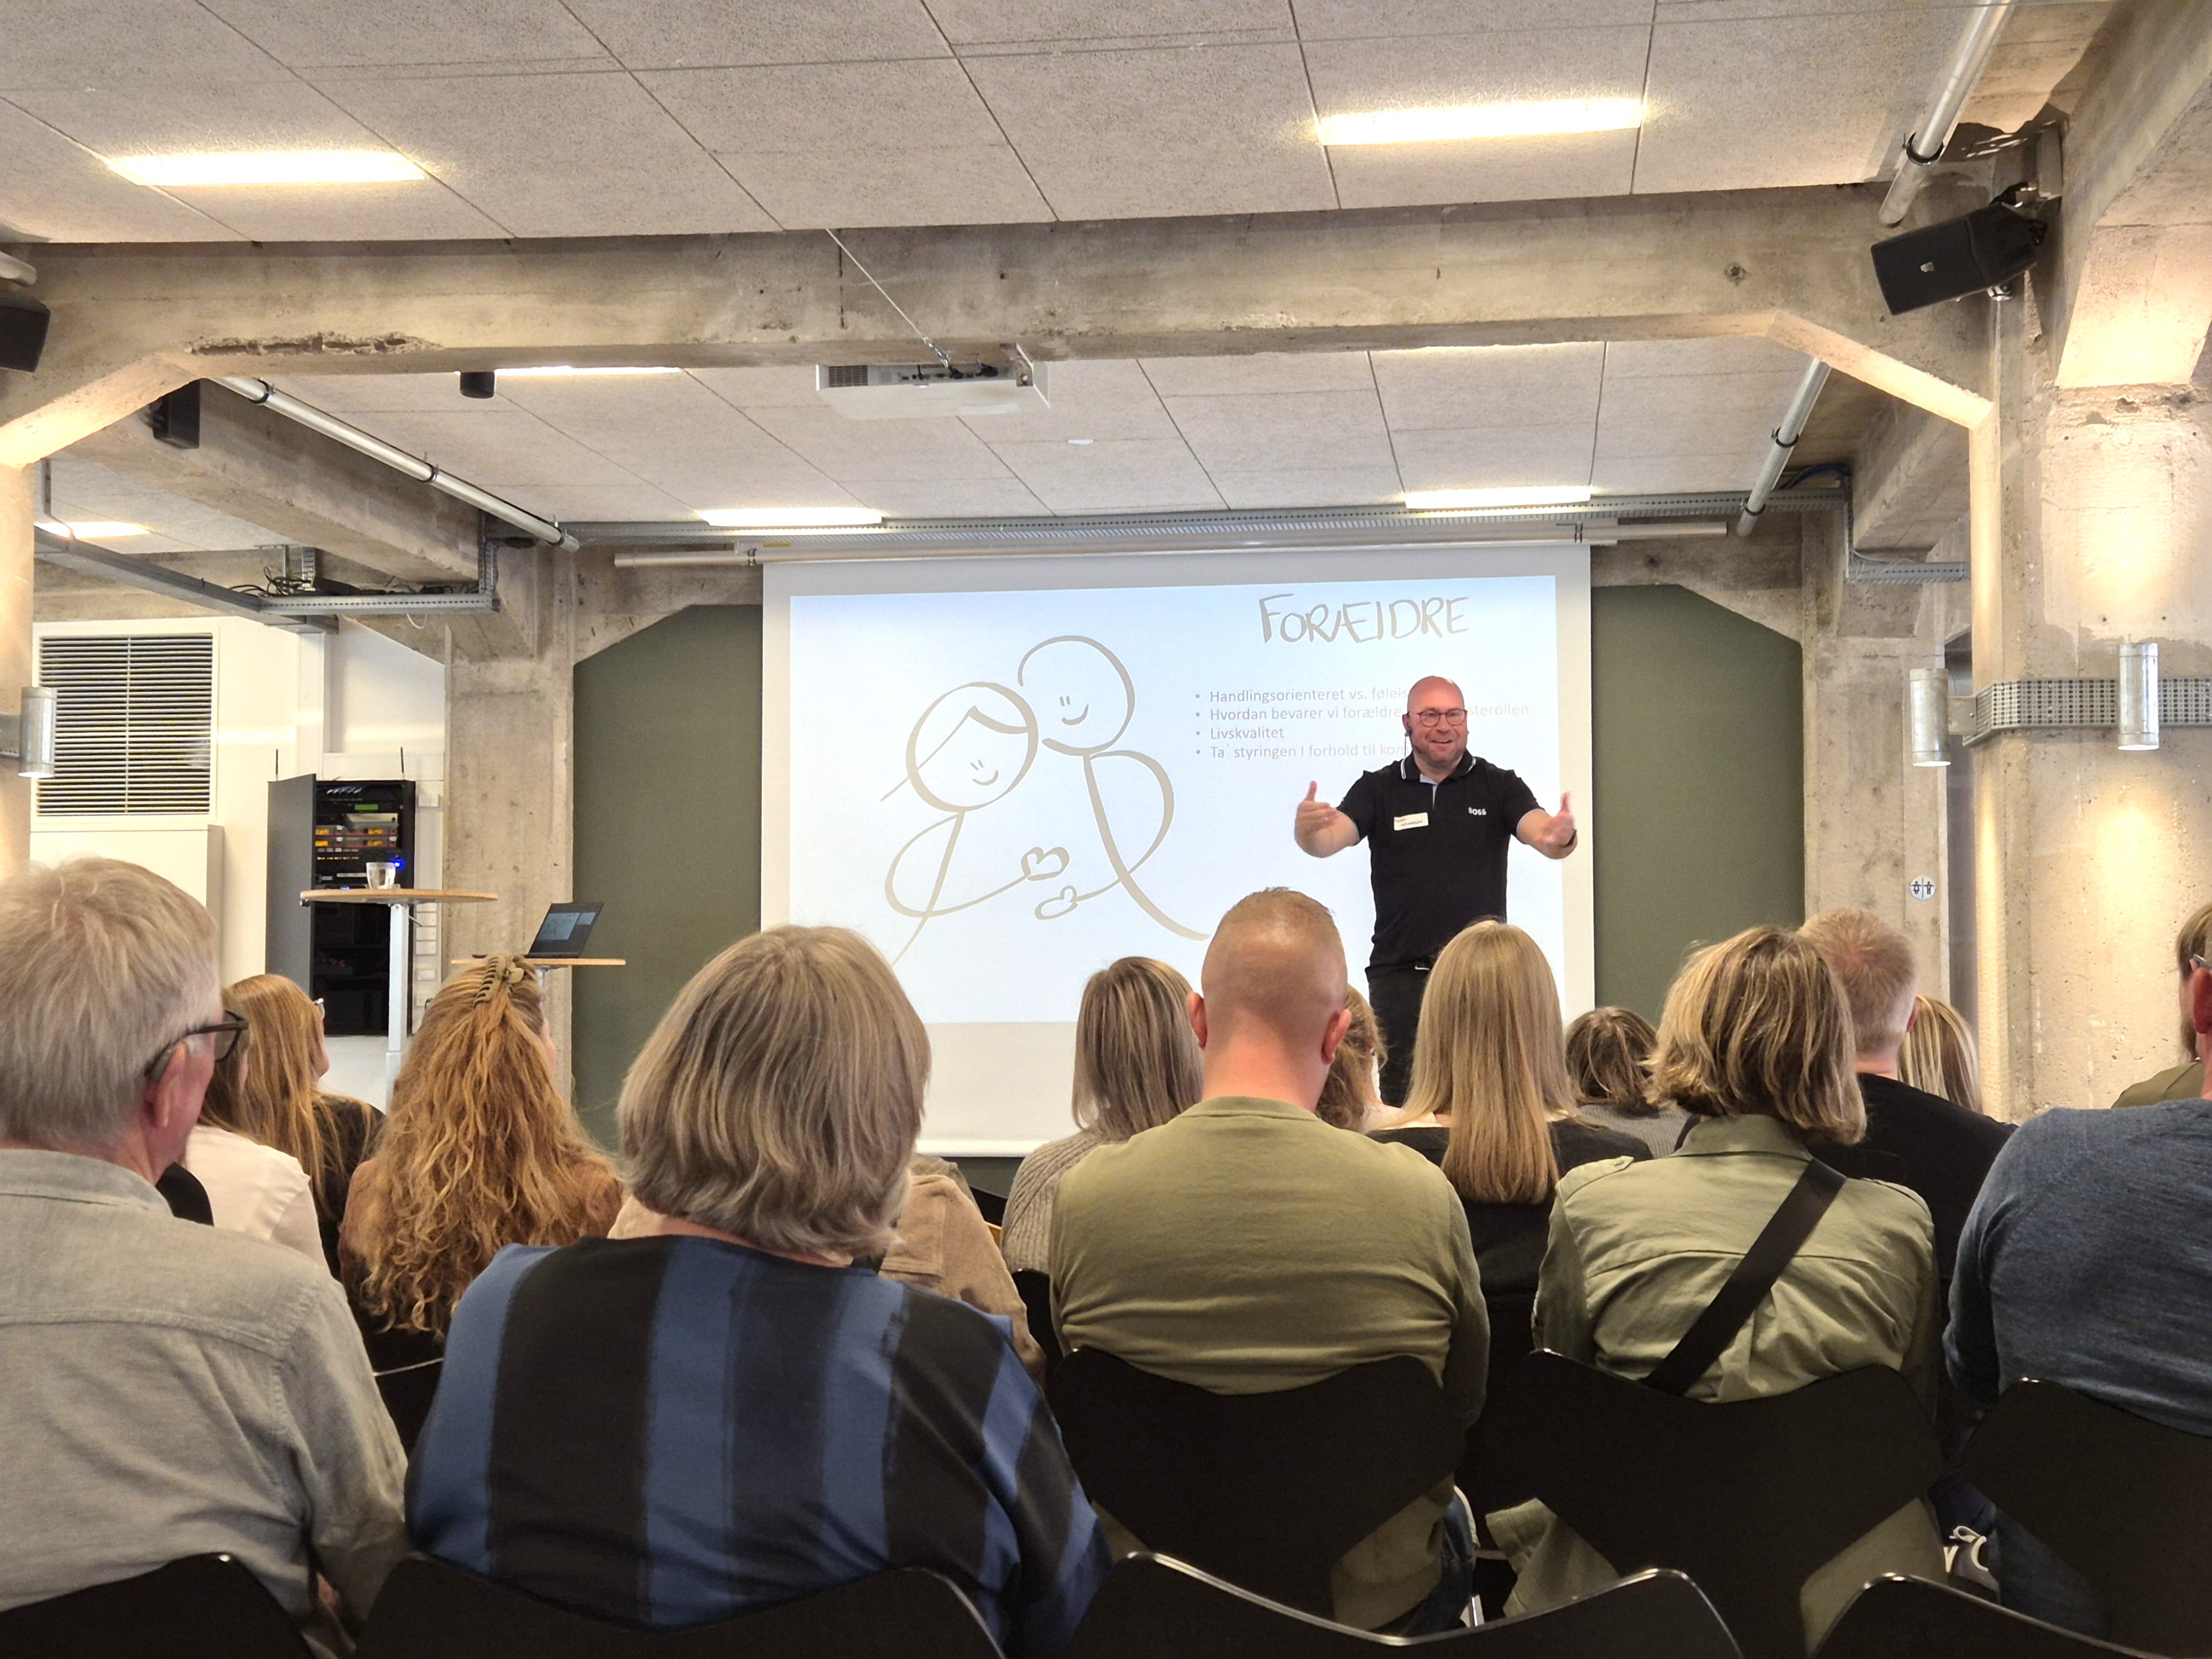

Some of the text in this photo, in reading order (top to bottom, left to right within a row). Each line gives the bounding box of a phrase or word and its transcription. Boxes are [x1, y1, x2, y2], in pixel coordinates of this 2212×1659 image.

[1210, 687, 1408, 704] Handlingsorienteret vs. følels
[1210, 708, 1267, 721] Hvordan
[1271, 707, 1323, 719] bevarer
[1327, 706, 1338, 718] vi
[1468, 703, 1529, 716] sterollen
[1211, 726, 1285, 740] Livskvalitet
[1234, 745, 1296, 760] styringen
[1309, 744, 1358, 757] forhold
[1362, 744, 1376, 756] til
